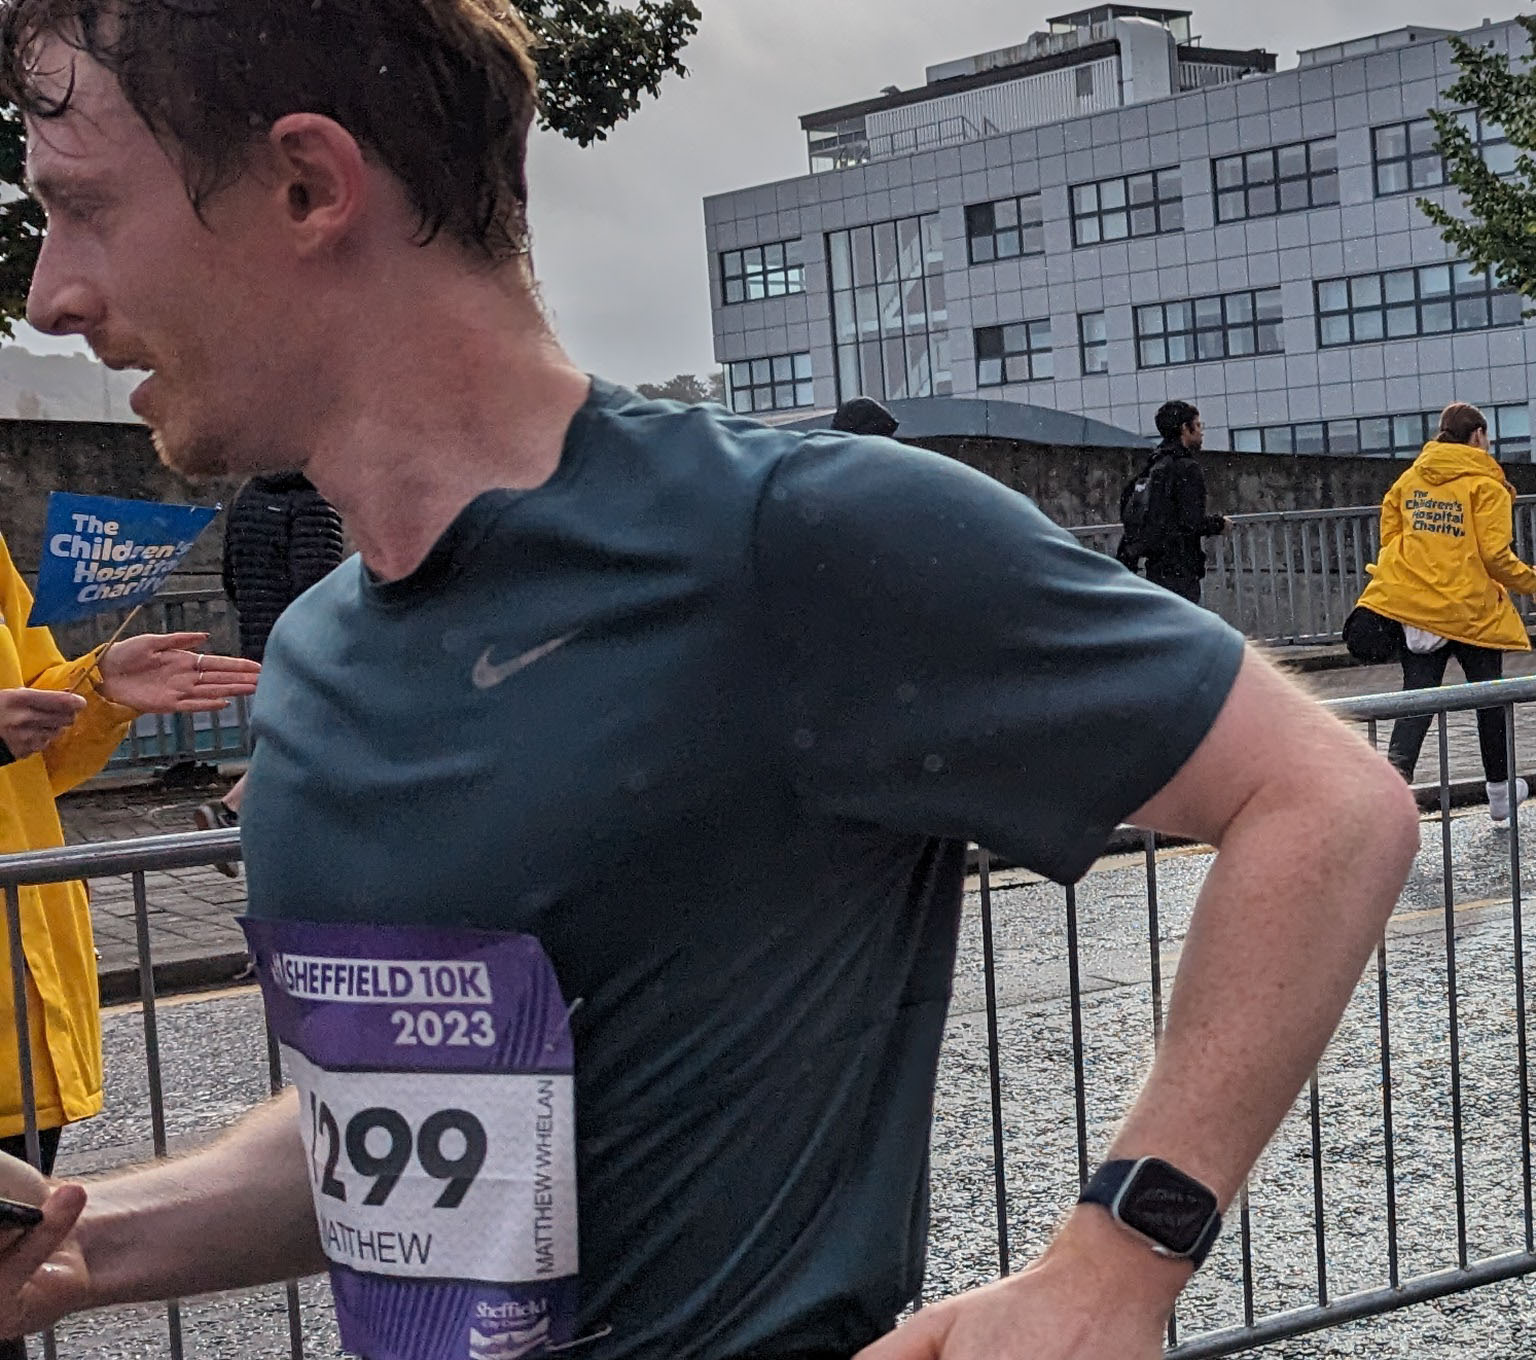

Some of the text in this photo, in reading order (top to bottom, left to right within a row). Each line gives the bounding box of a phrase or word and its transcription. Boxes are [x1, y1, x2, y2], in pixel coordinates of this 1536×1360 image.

[1405, 498, 1462, 511] Children's
[1412, 510, 1464, 524] Hospital
[71, 513, 120, 536] The
[285, 959, 488, 998] SHEFFIELD 10K
[391, 1010, 496, 1047] 2023
[534, 1079, 554, 1275] MATTHEW WHELAN
